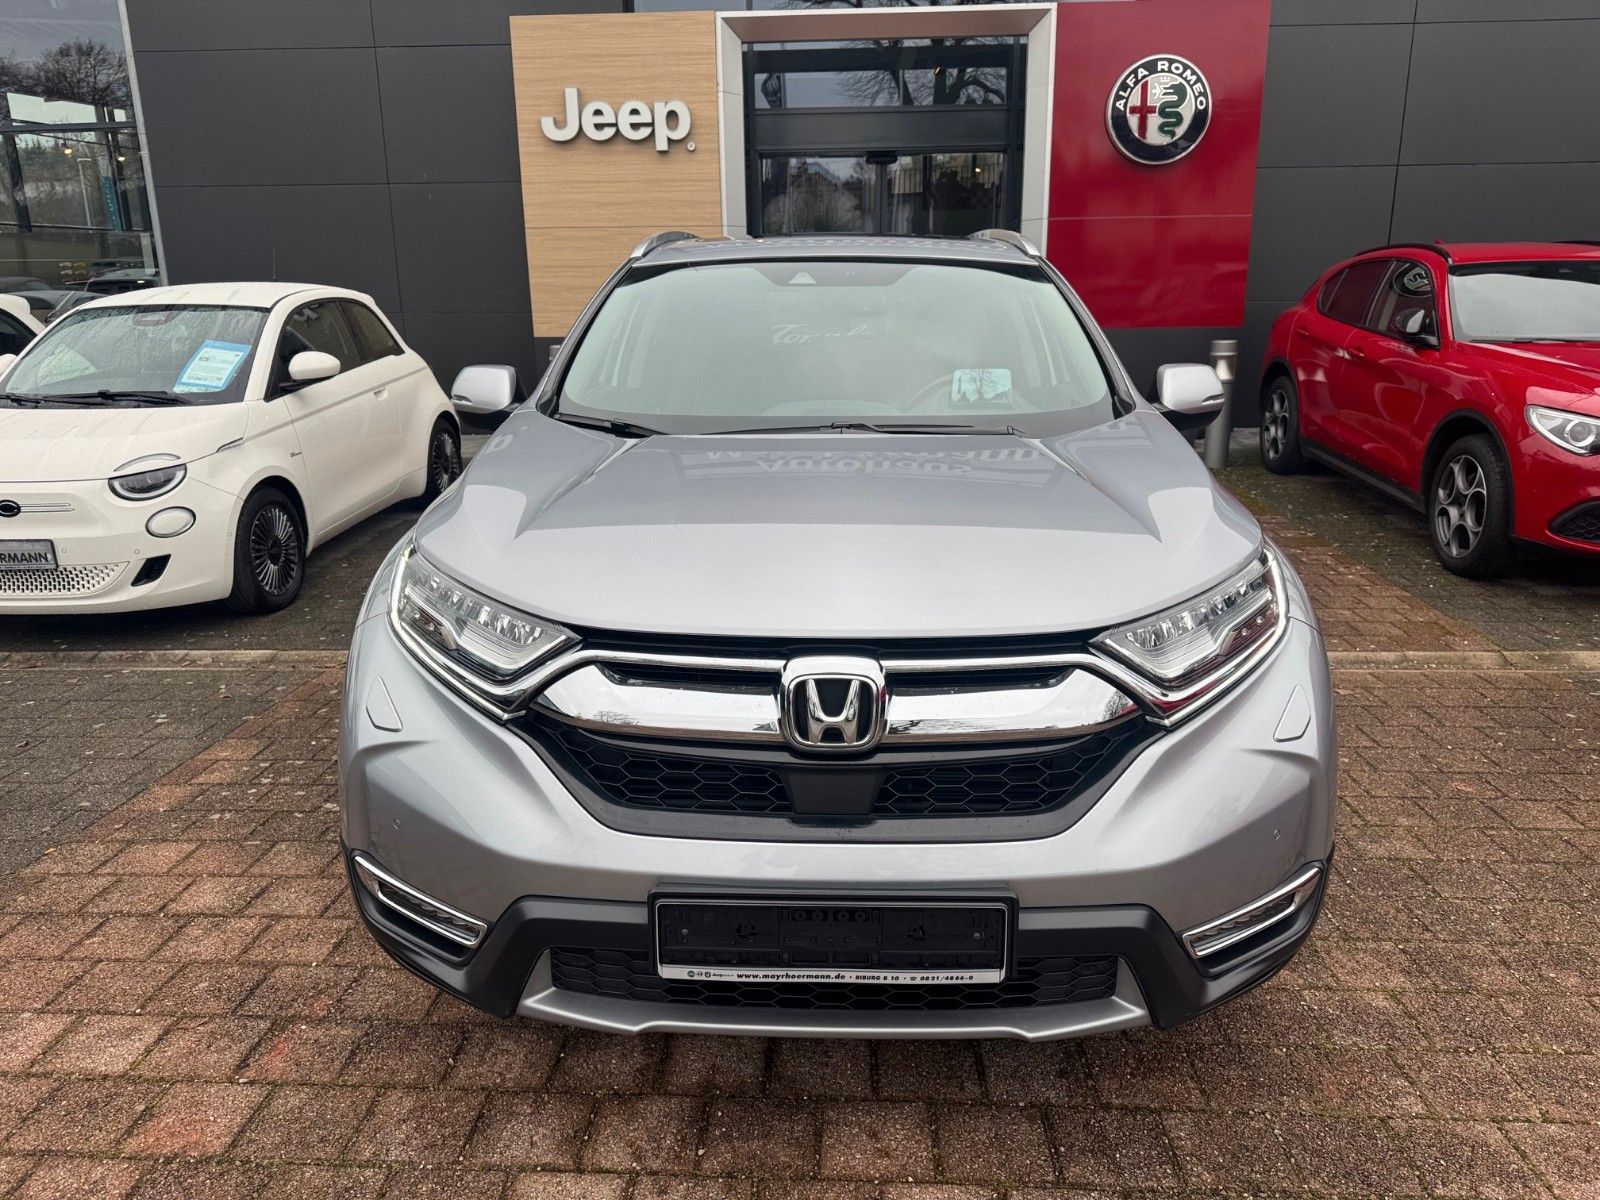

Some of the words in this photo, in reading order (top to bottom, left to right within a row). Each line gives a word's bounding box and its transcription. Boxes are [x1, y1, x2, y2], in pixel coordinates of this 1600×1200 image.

[1115, 67, 1149, 111] ALFA
[1157, 61, 1206, 110] ROMEO
[541, 87, 692, 152] Jeep
[736, 972, 846, 981] www.mayrhoermann.de
